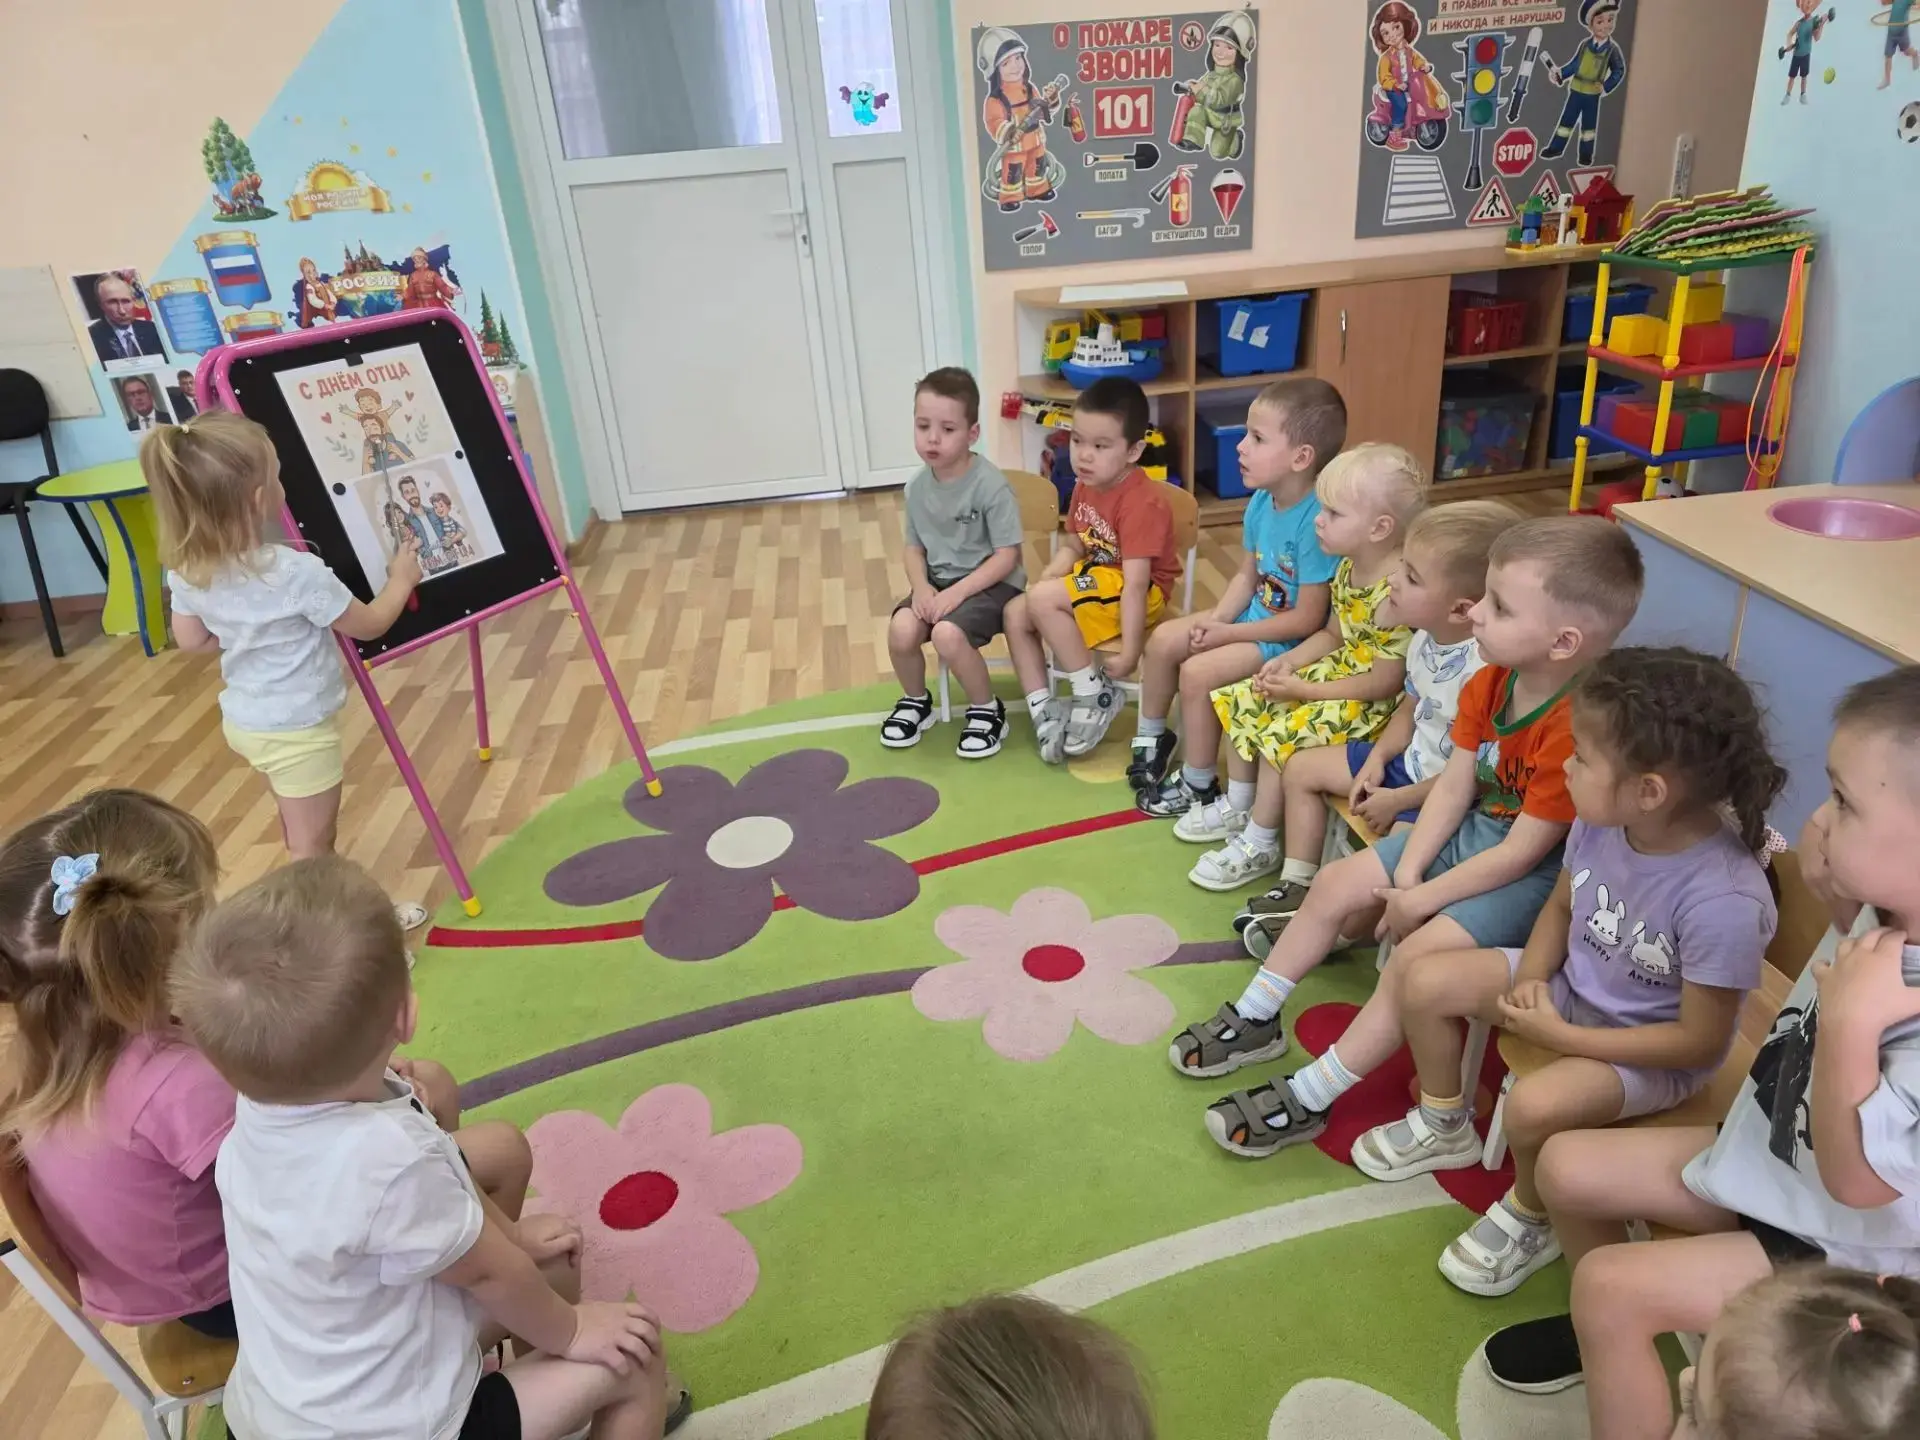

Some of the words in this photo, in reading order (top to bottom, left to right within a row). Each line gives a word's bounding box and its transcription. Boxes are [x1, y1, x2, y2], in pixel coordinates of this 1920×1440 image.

[1441, 3, 1447, 12] Я
[1054, 24, 1069, 48] О
[1079, 19, 1171, 48] ПОЖАРЕ
[1430, 22, 1437, 32] И
[1443, 18, 1488, 30] НИКОГДА
[1493, 16, 1505, 25] НЕ
[1510, 11, 1562, 25] НАРУШАЮ
[1077, 47, 1172, 83] ЗВОНИ
[1098, 94, 1148, 129] 101
[1499, 144, 1532, 162] STOP
[1155, 229, 1205, 241] ОГНЕТУШИТЕЛЬ
[333, 274, 400, 292] РОССИЯ
[299, 382, 313, 400] С
[316, 371, 364, 399] ДНЁМ
[366, 361, 410, 385] ОТЦА
[1583, 933, 1611, 962] Happy
